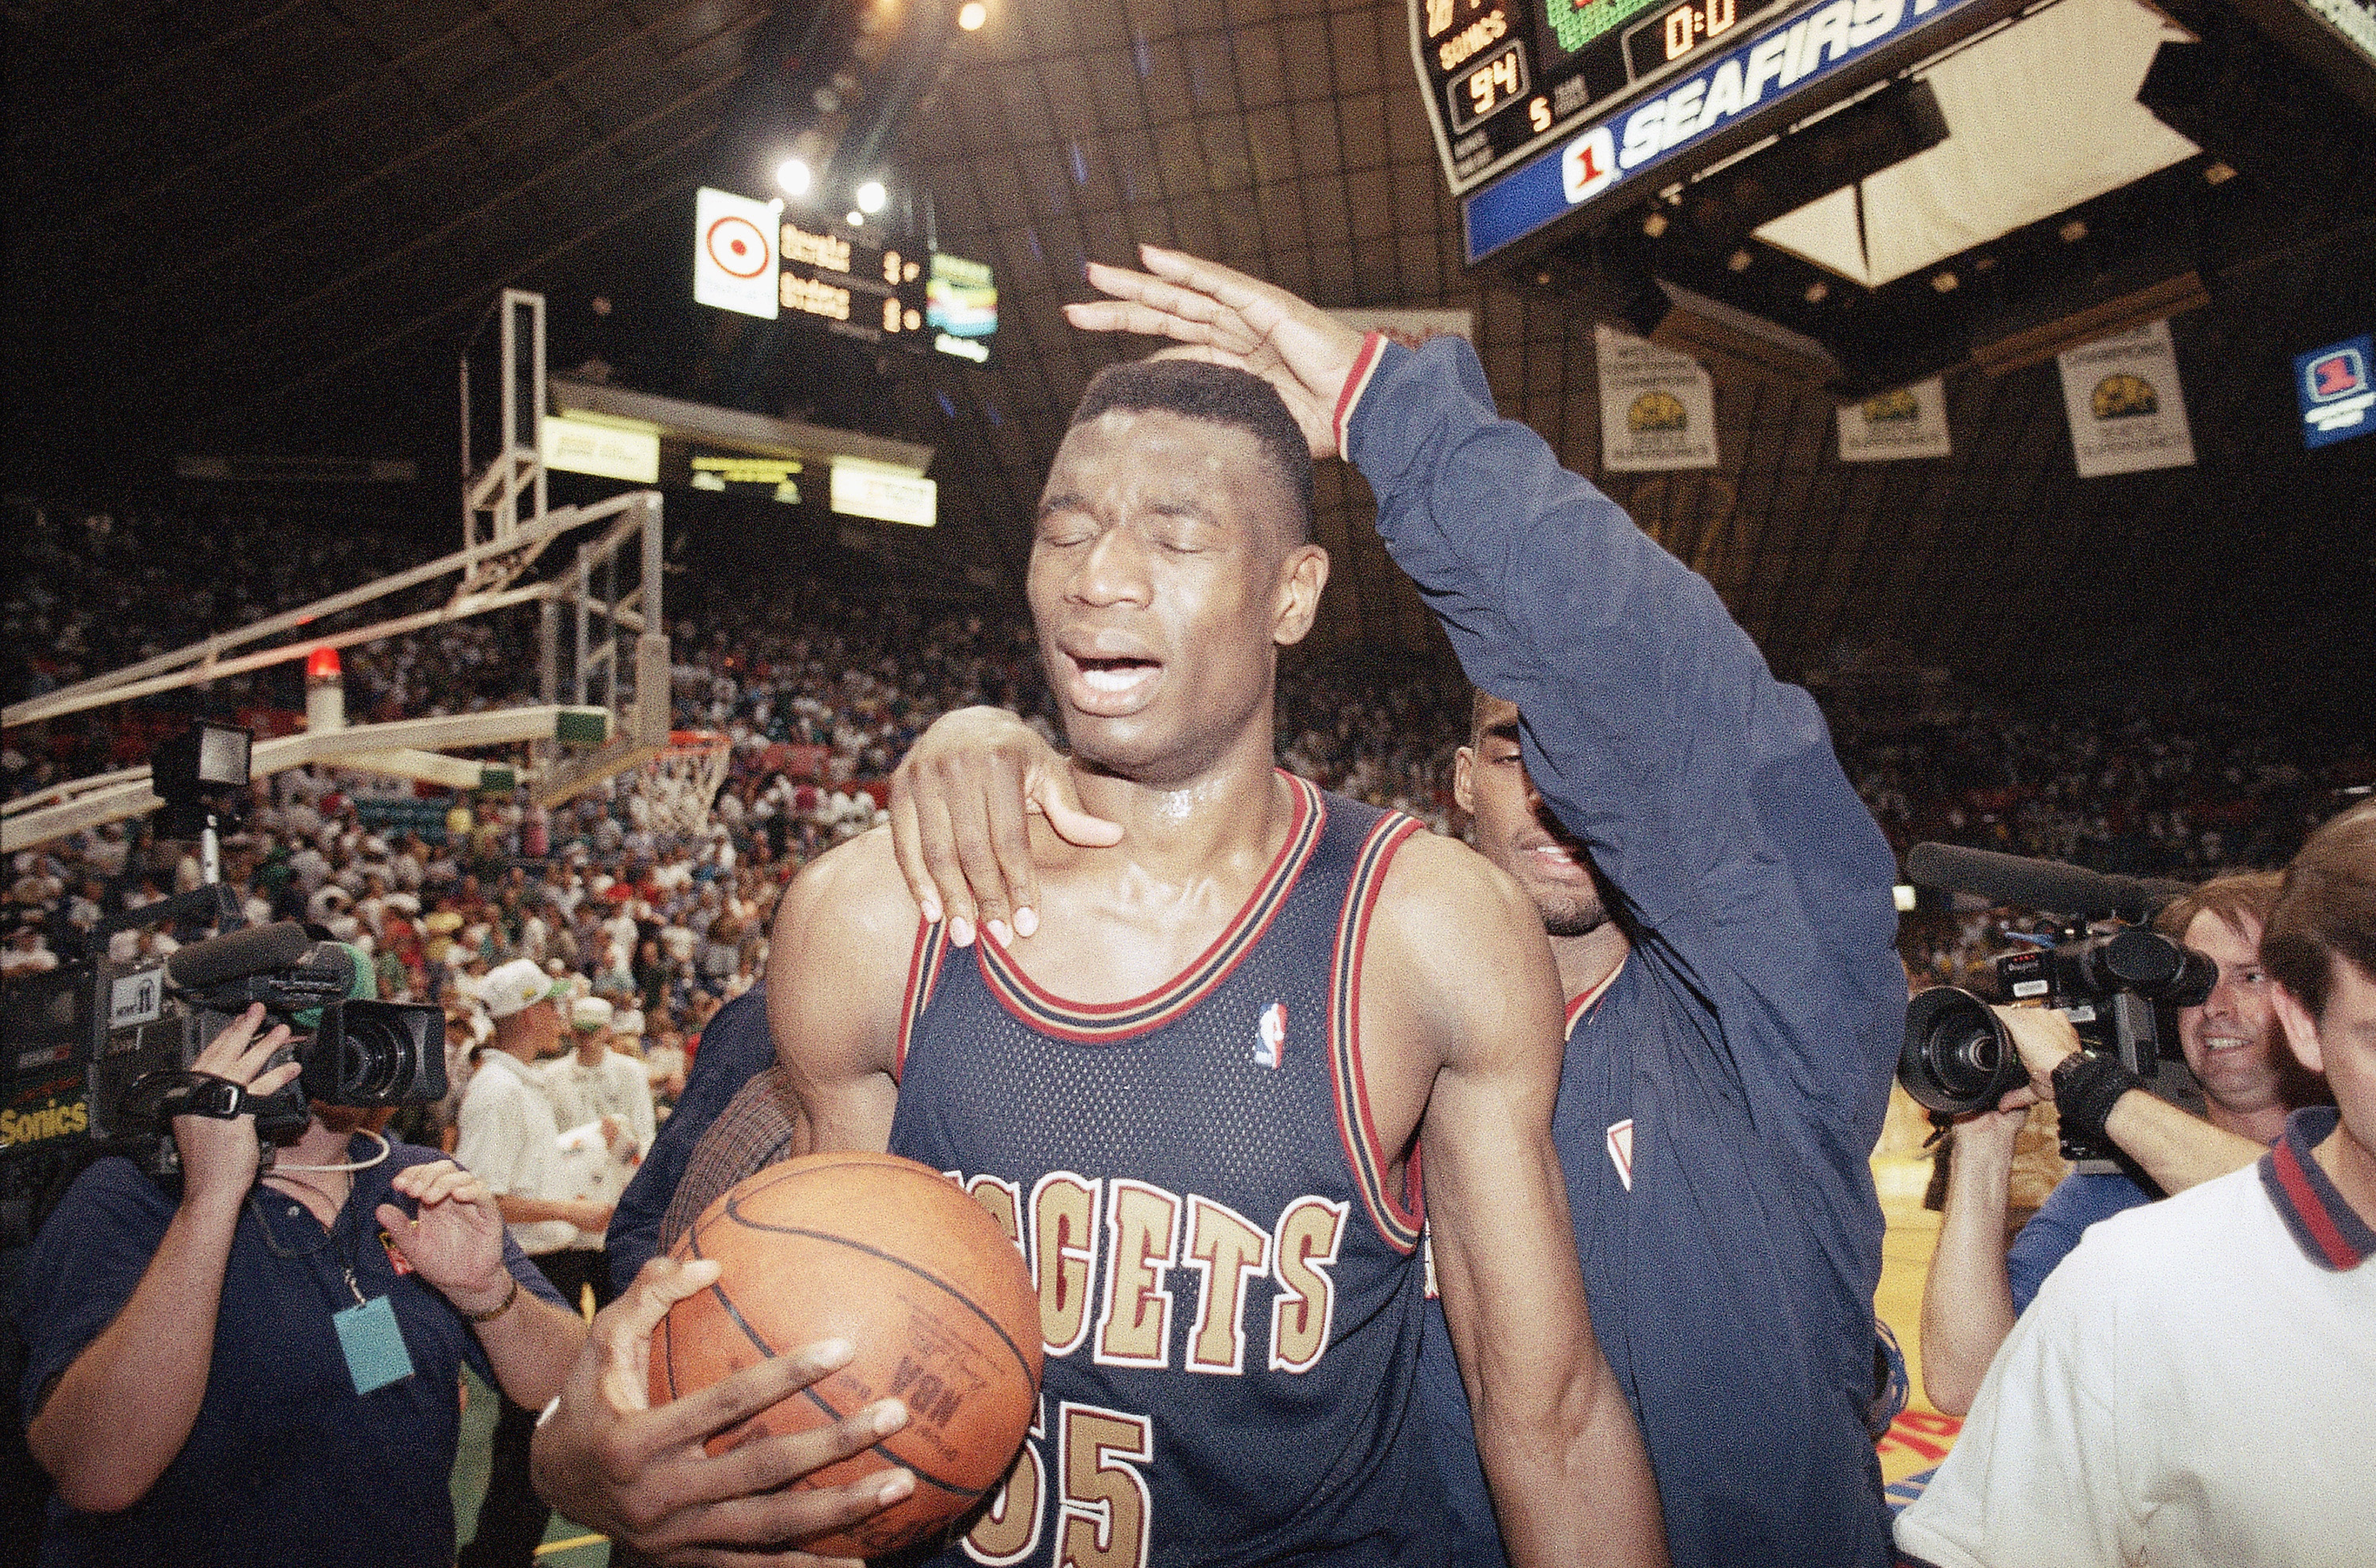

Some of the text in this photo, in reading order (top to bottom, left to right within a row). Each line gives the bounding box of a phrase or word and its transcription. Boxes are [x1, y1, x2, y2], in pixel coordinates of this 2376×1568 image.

[1470, 52, 1518, 114] 94
[1619, 0, 1939, 169] SEAFIRS
[0, 1098, 89, 1147] Sonics
[942, 1171, 1349, 1375] GETS
